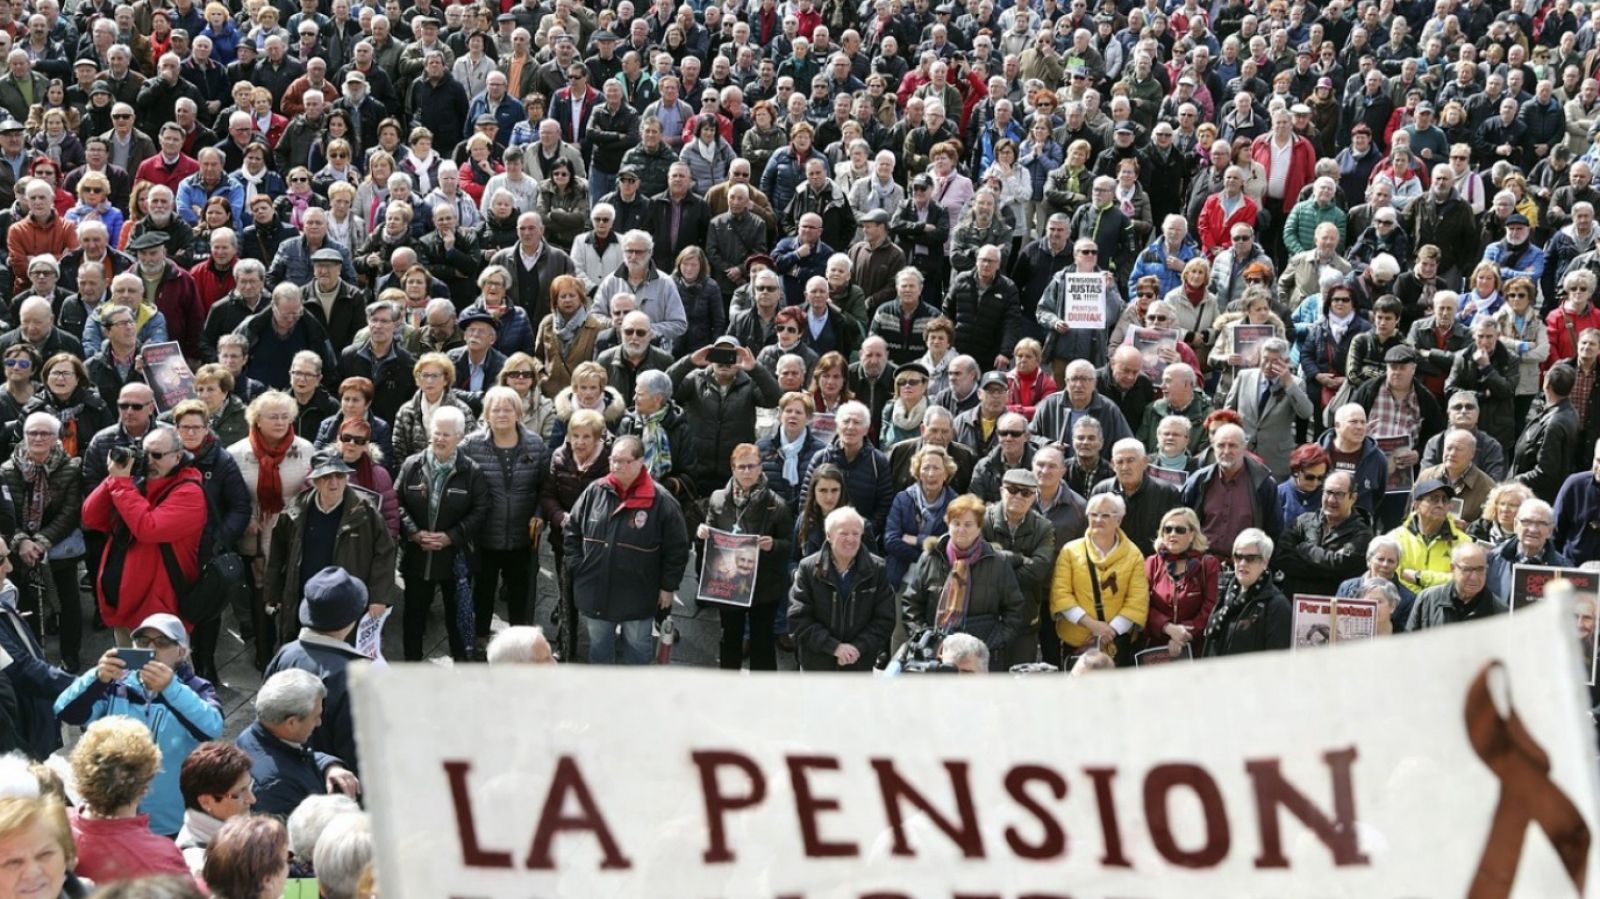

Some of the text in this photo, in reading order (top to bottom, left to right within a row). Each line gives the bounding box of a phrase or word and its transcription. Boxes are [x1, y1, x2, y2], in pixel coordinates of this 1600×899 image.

[1068, 284, 1102, 294] JUSTAS
[1068, 312, 1103, 322] DUINAK
[1299, 602, 1320, 614] Por
[442, 745, 1370, 870] LA PENSION
